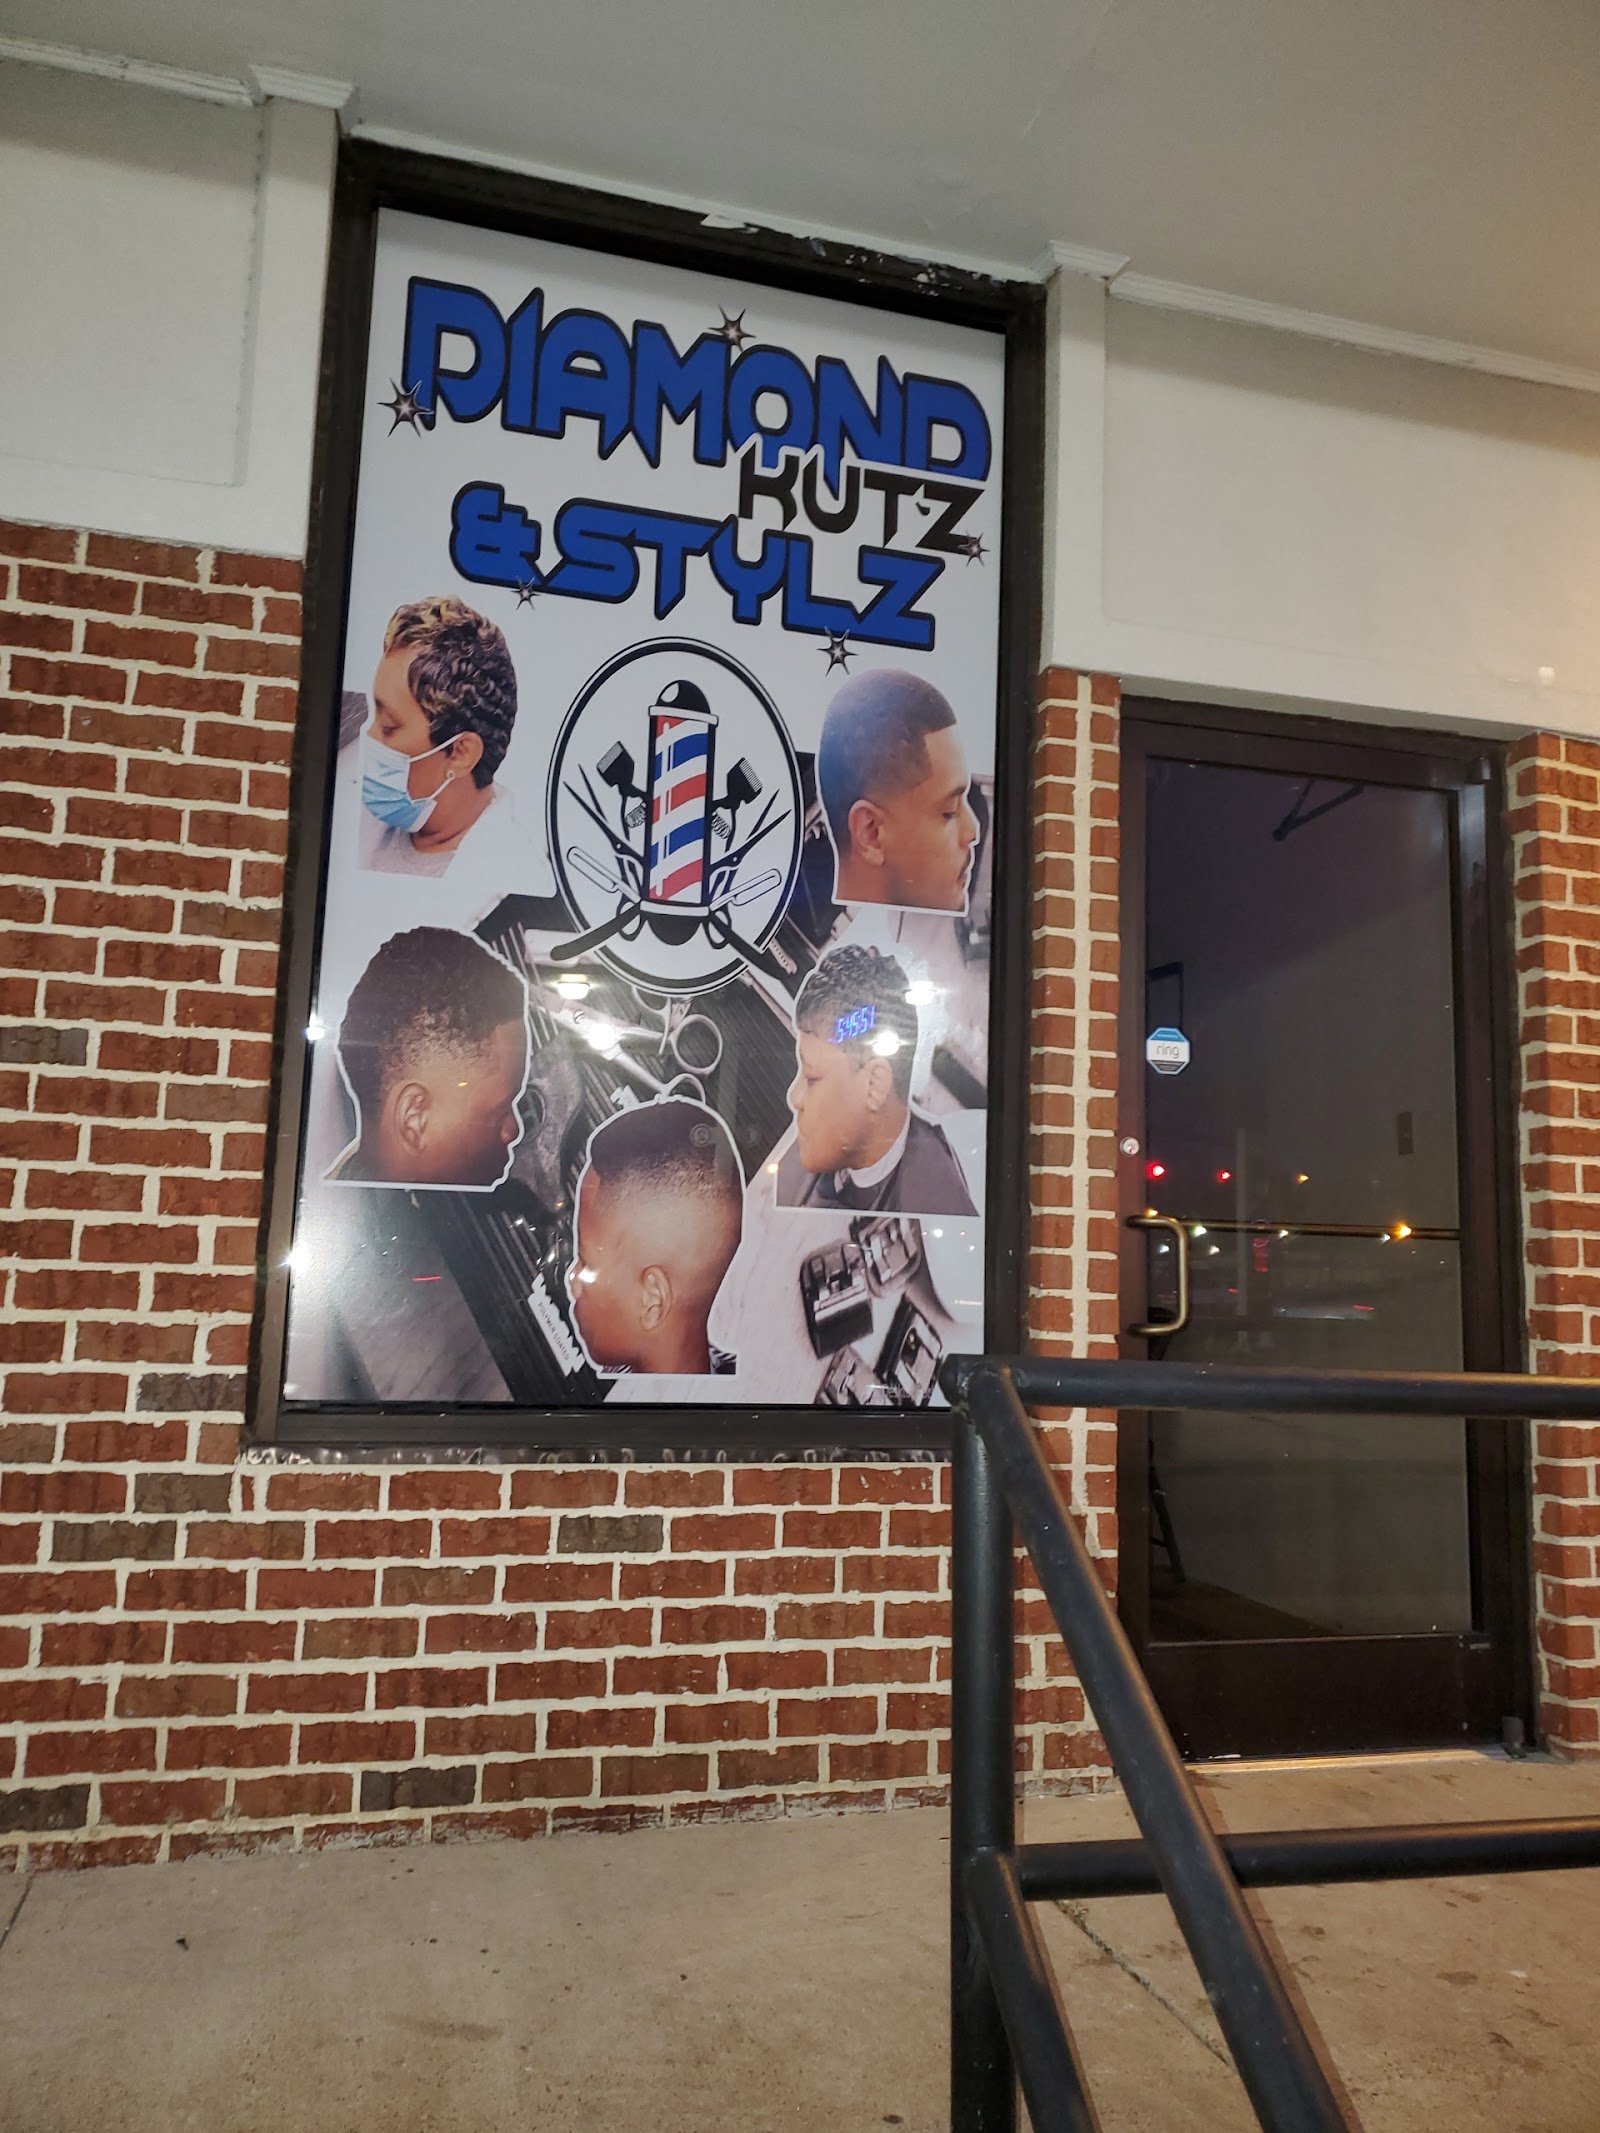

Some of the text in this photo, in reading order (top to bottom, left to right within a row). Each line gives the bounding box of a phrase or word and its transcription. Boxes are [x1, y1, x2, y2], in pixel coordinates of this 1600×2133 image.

[402, 275, 992, 488] DIAMOND
[738, 440, 986, 555] KUTZ
[1156, 1043, 1179, 1059] ring
